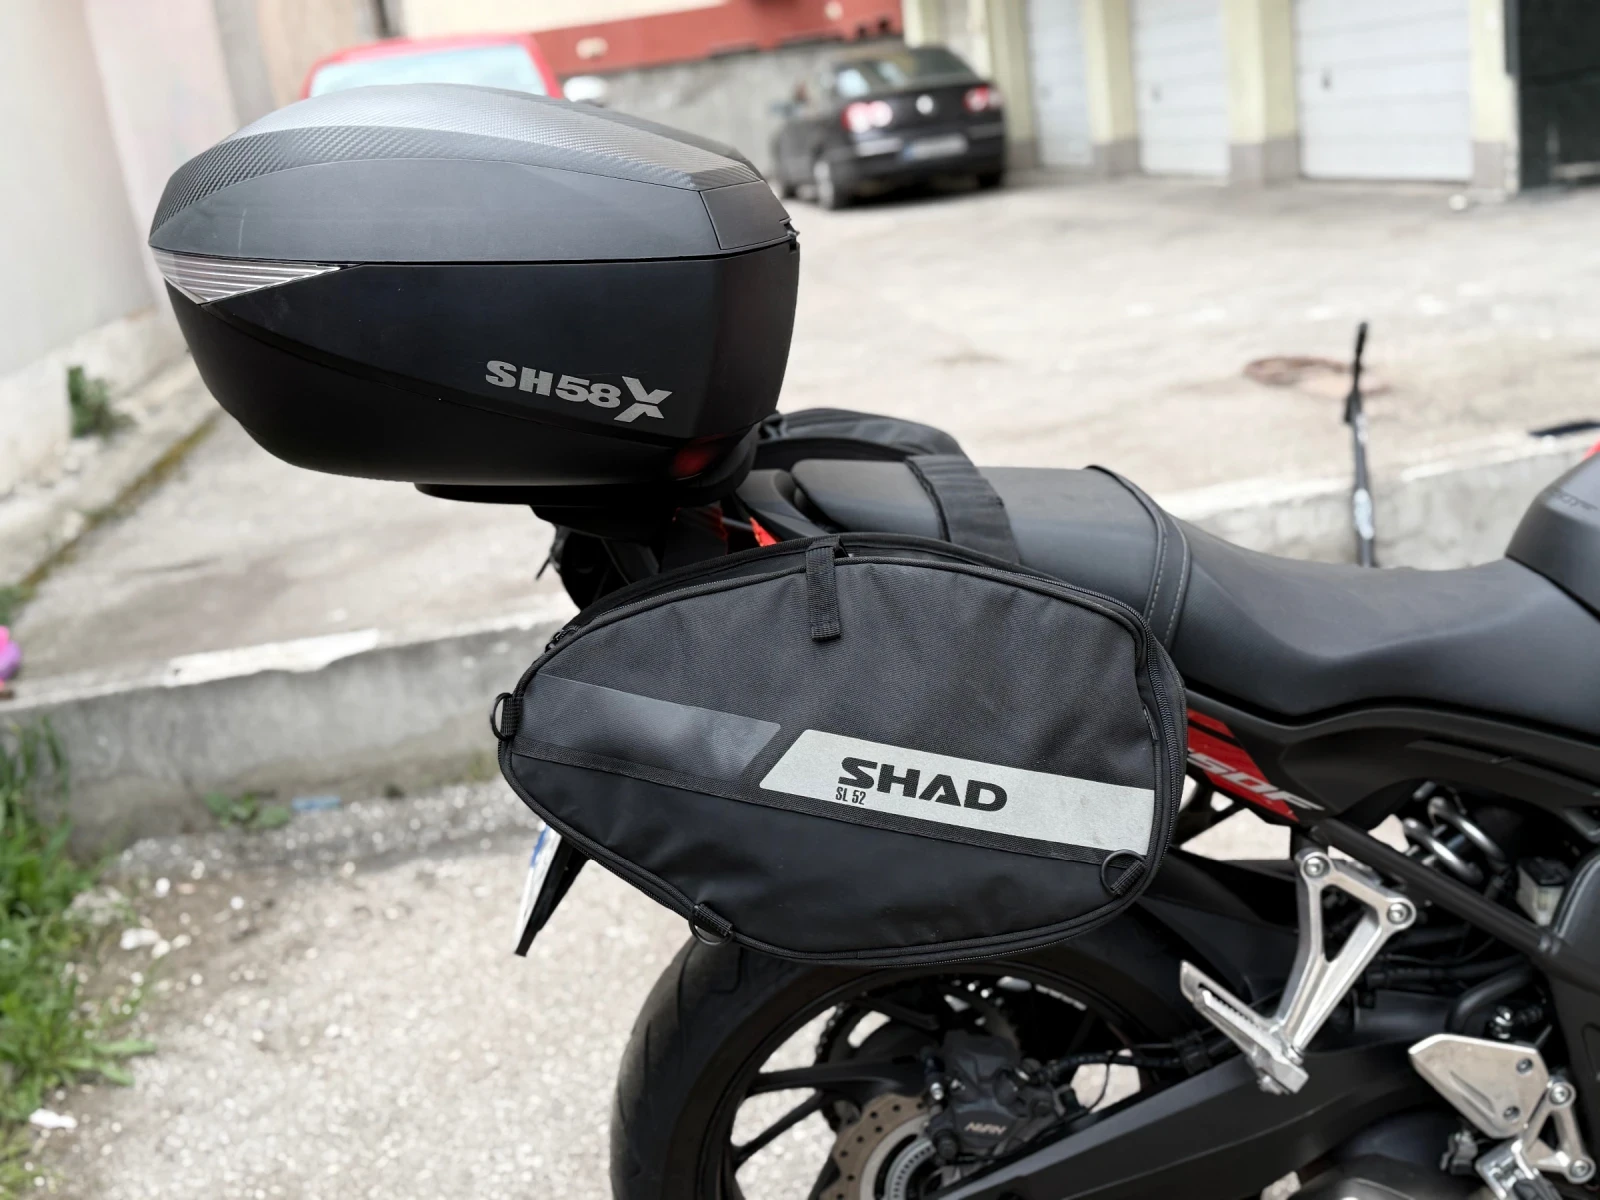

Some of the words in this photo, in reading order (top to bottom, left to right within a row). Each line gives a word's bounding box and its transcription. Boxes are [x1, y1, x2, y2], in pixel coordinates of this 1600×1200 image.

[485, 360, 673, 423] SH58X
[835, 786, 848, 802] SL
[851, 789, 867, 806] 52
[838, 756, 1008, 812] SHAD
[1187, 747, 1326, 811] 50R
